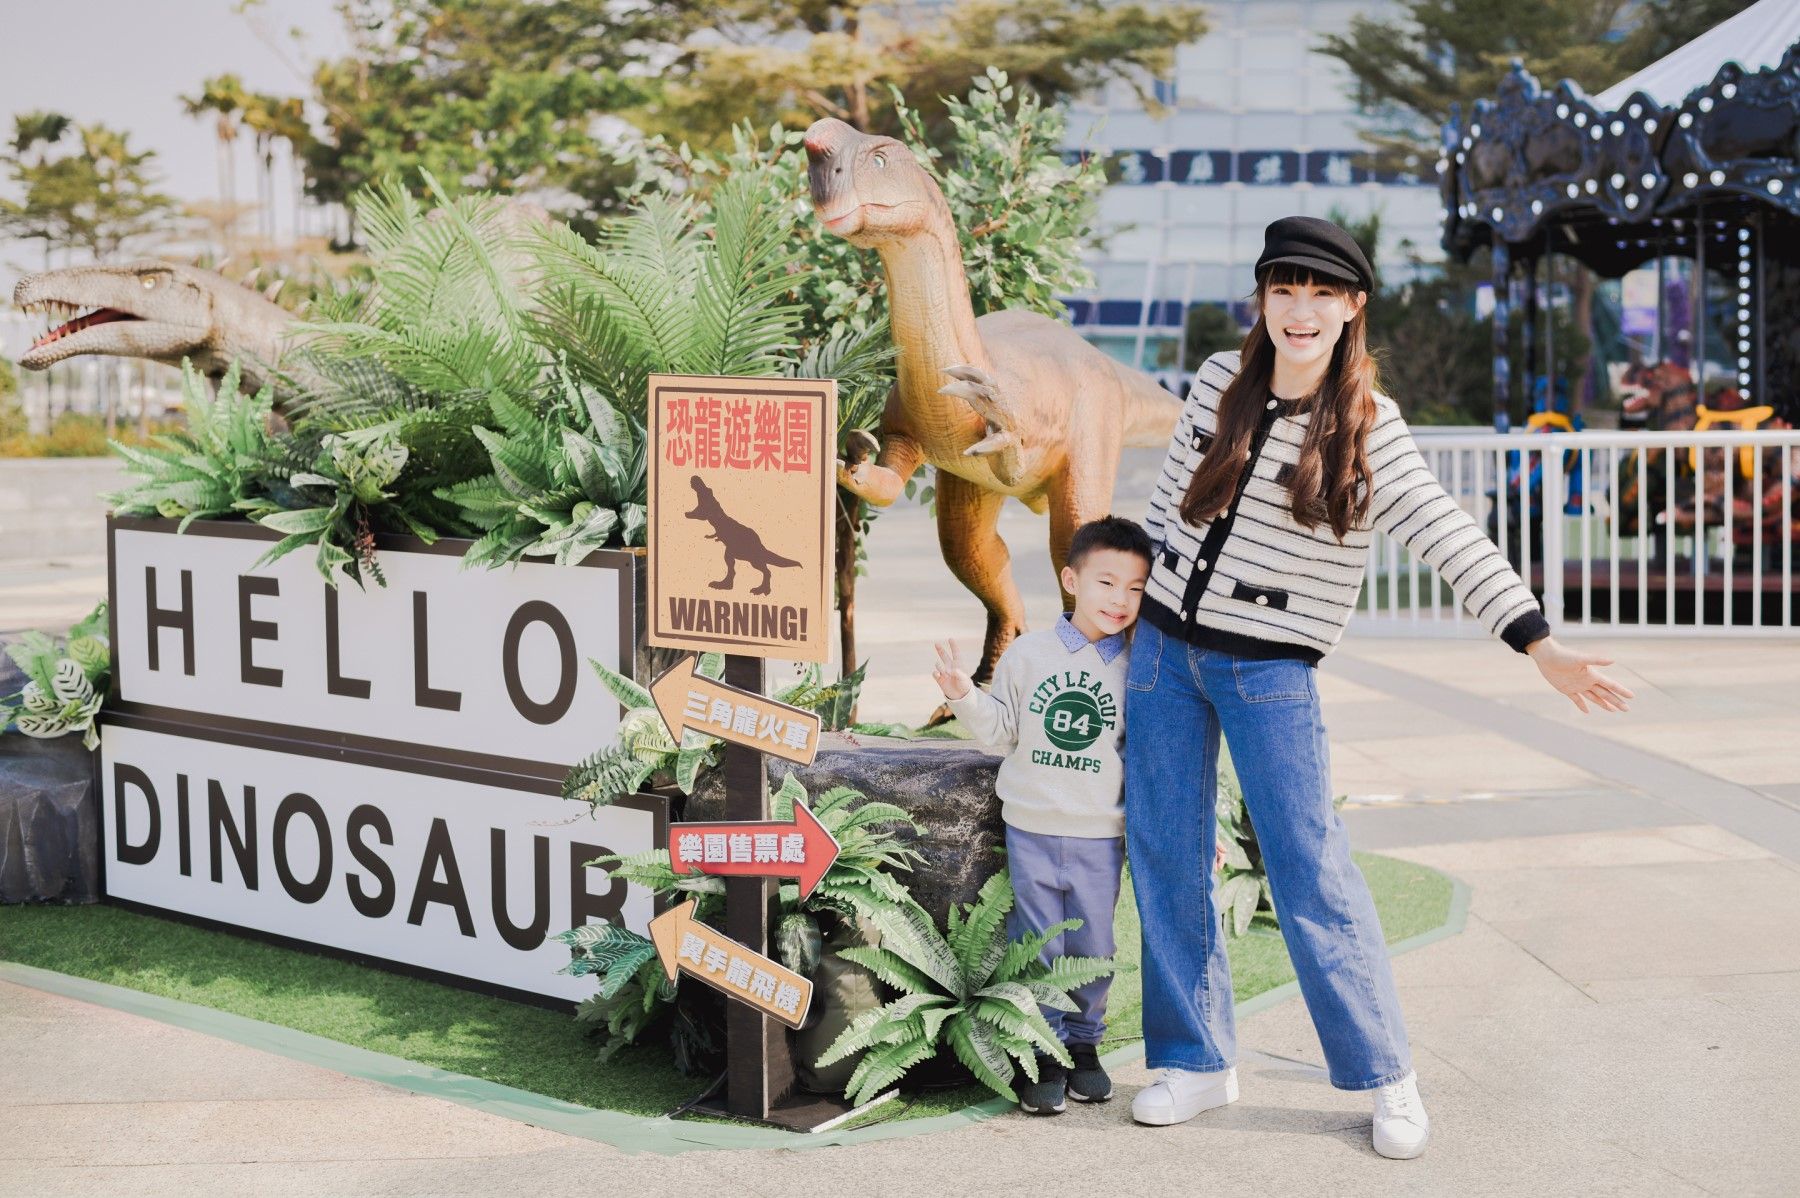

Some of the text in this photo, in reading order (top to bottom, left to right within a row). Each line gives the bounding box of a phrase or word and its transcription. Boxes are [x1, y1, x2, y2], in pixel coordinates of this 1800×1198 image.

[665, 396, 813, 474] 恐龍遊樂園
[668, 596, 808, 642] WARNING!
[144, 566, 579, 726] HELLO
[682, 690, 811, 750] 三角龍火車
[1028, 674, 1061, 715] CITY
[1052, 709, 1091, 736] 84
[1031, 749, 1102, 774] CHAMPS
[113, 762, 628, 957] DINOSAUR
[678, 833, 805, 863] 樂園售票處
[679, 931, 802, 1015] 翼手龍飛機
